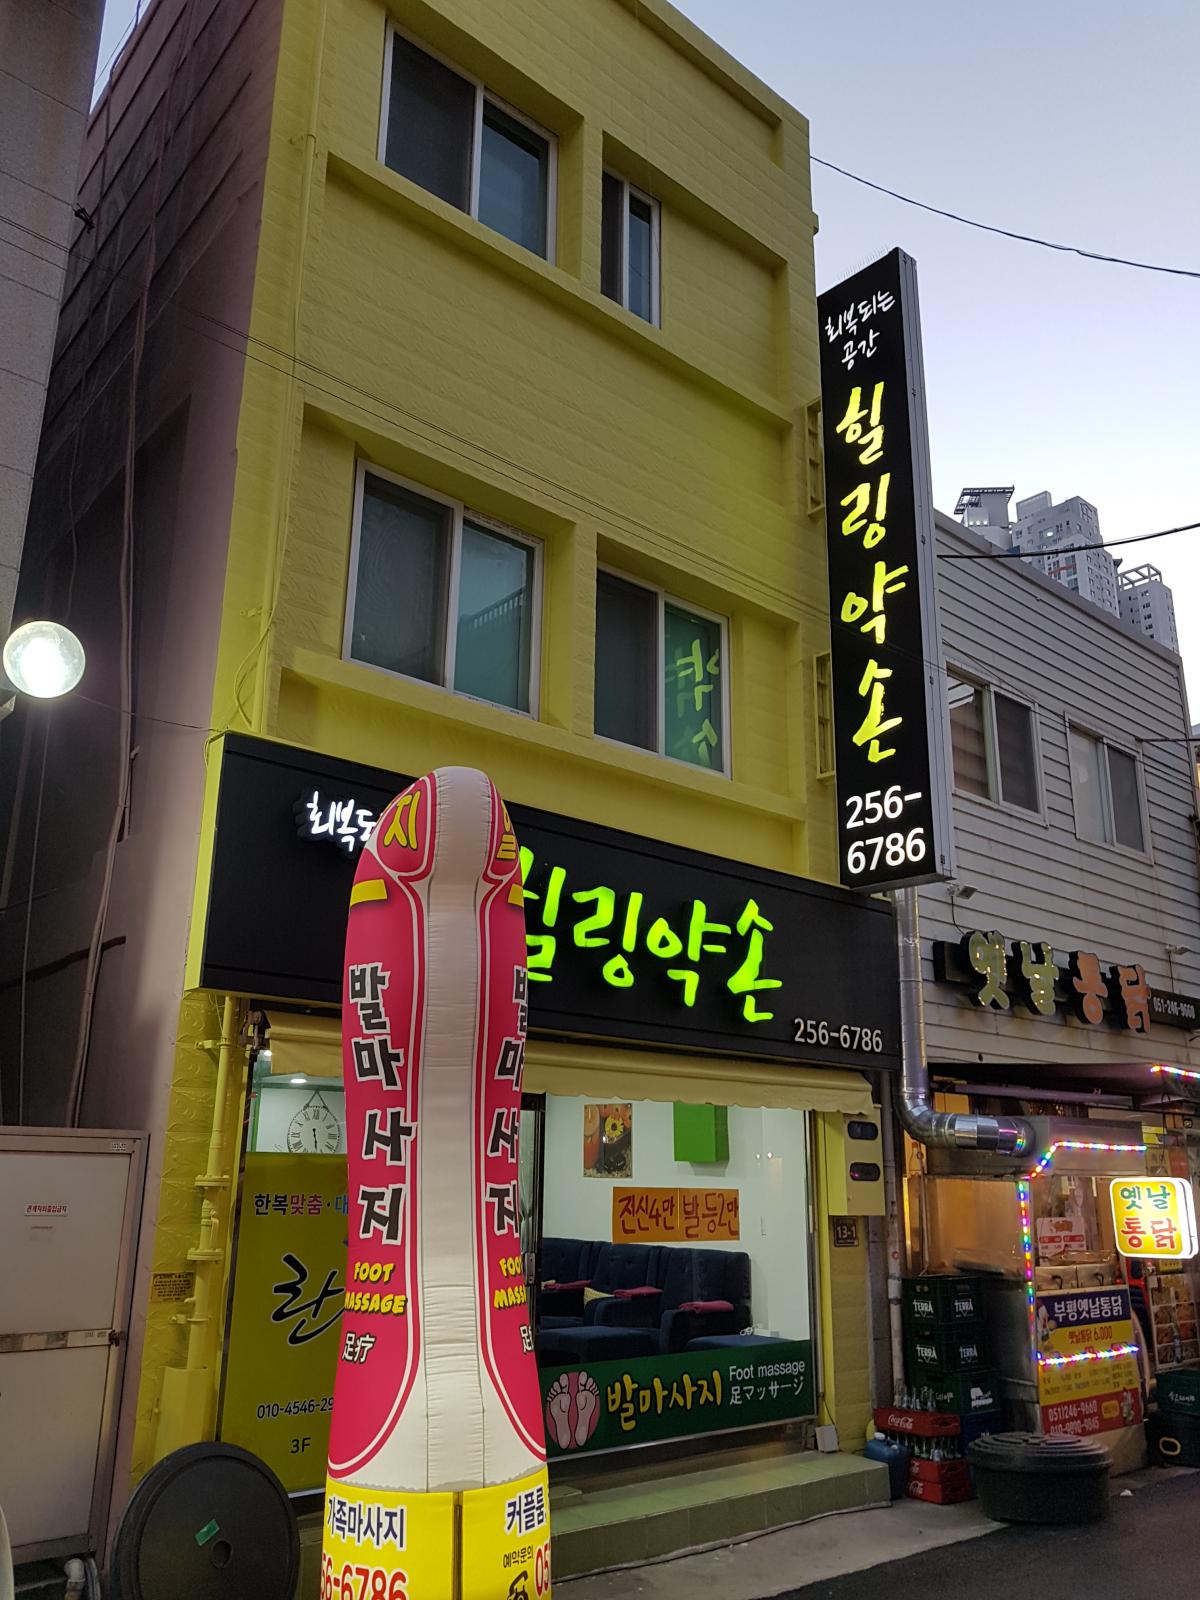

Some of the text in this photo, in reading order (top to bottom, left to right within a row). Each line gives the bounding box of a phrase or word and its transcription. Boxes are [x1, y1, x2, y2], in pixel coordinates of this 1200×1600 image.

[824, 290, 896, 343] 회복되는
[841, 328, 880, 371] 공간
[836, 381, 909, 763] 힐링약손
[845, 785, 922, 830] 256-
[847, 827, 926, 876] 6786
[794, 1017, 883, 1053] 256-6786
[1120, 1186, 1170, 1210] 옛날
[836, 1225, 856, 1239] 13-1
[1120, 1218, 1177, 1249] 통닭
[353, 1262, 395, 1283] FOOT
[913, 1300, 934, 1313] TERRA
[954, 1299, 974, 1312] TERRA
[1054, 1296, 1123, 1322] 부평옛날통닭
[342, 1332, 375, 1363] 足疗
[916, 1344, 937, 1359] TERRA
[959, 1344, 978, 1359] TERRA
[729, 1360, 806, 1382] Foot massage
[607, 1369, 722, 1431] 발마사지
[729, 1376, 804, 1406] 足マッサージ
[290, 1437, 311, 1454] 3F
[503, 1546, 533, 1568] 예약문의
